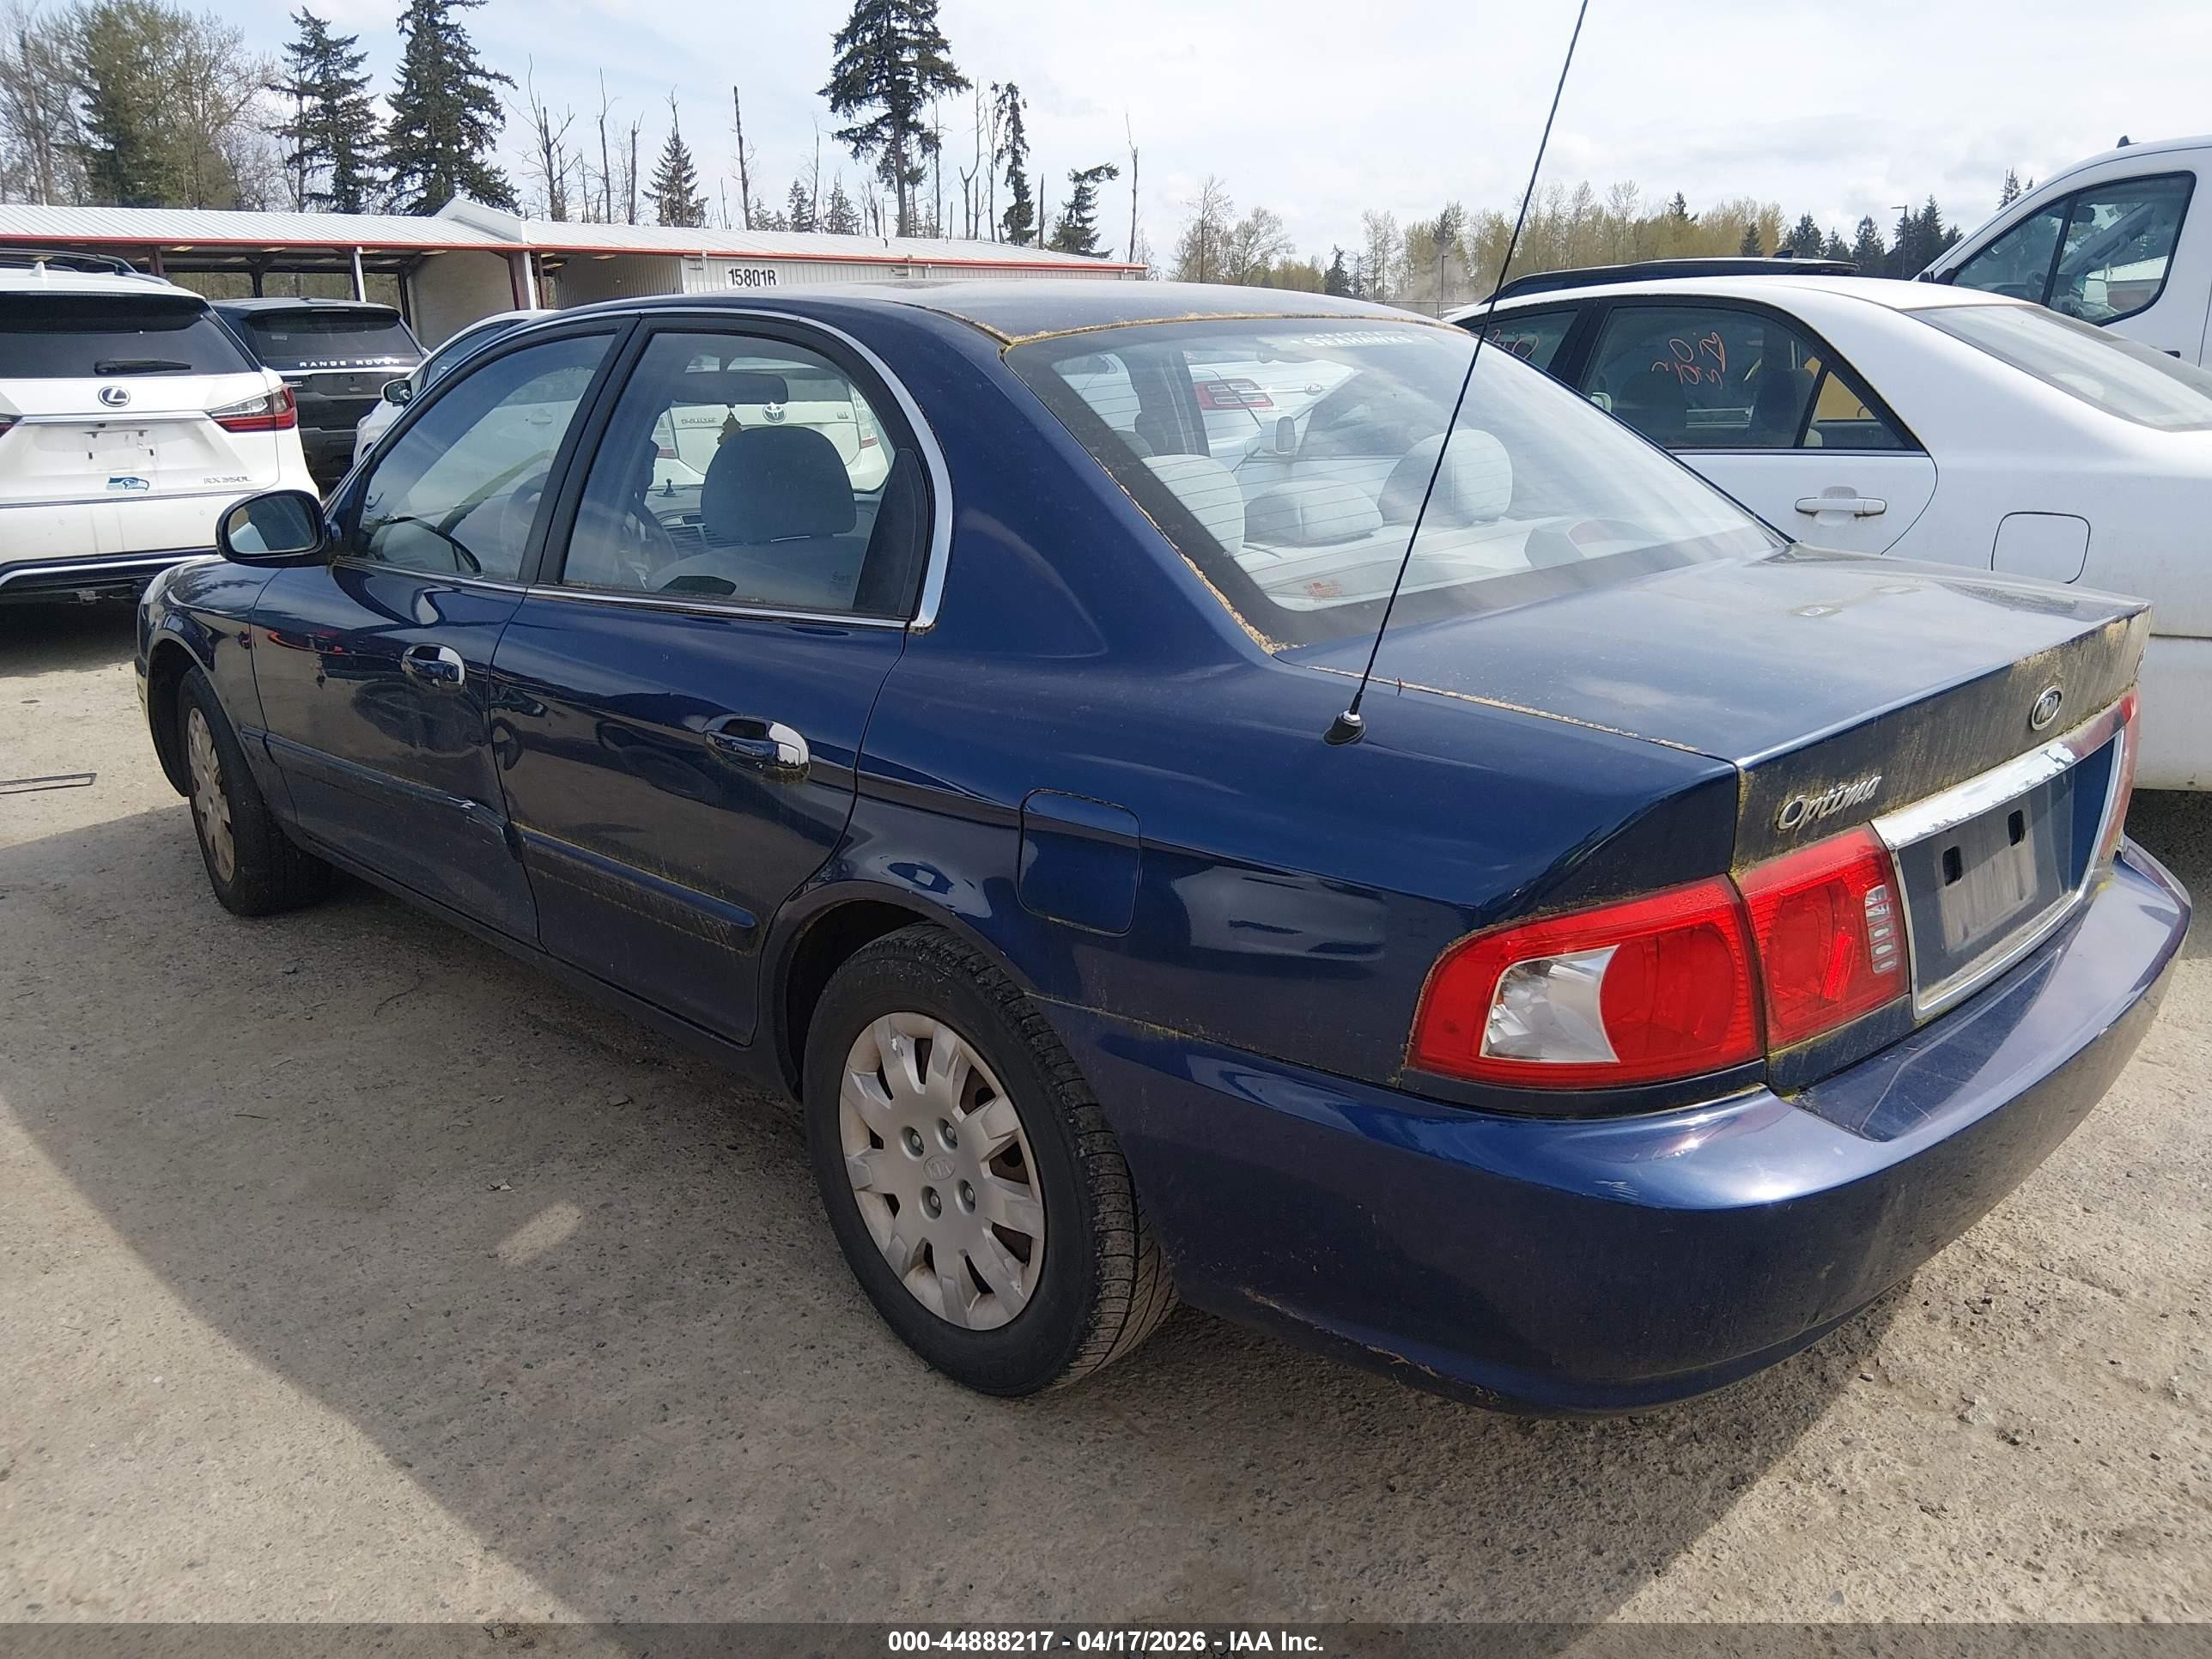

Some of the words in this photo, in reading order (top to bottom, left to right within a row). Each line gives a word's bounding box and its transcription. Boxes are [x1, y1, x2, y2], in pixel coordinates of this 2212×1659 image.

[728, 268, 777, 287] 15801R
[1304, 334, 1413, 347] SEAHAWKS
[356, 357, 400, 367] ROVER
[1778, 775, 1882, 832] Optima
